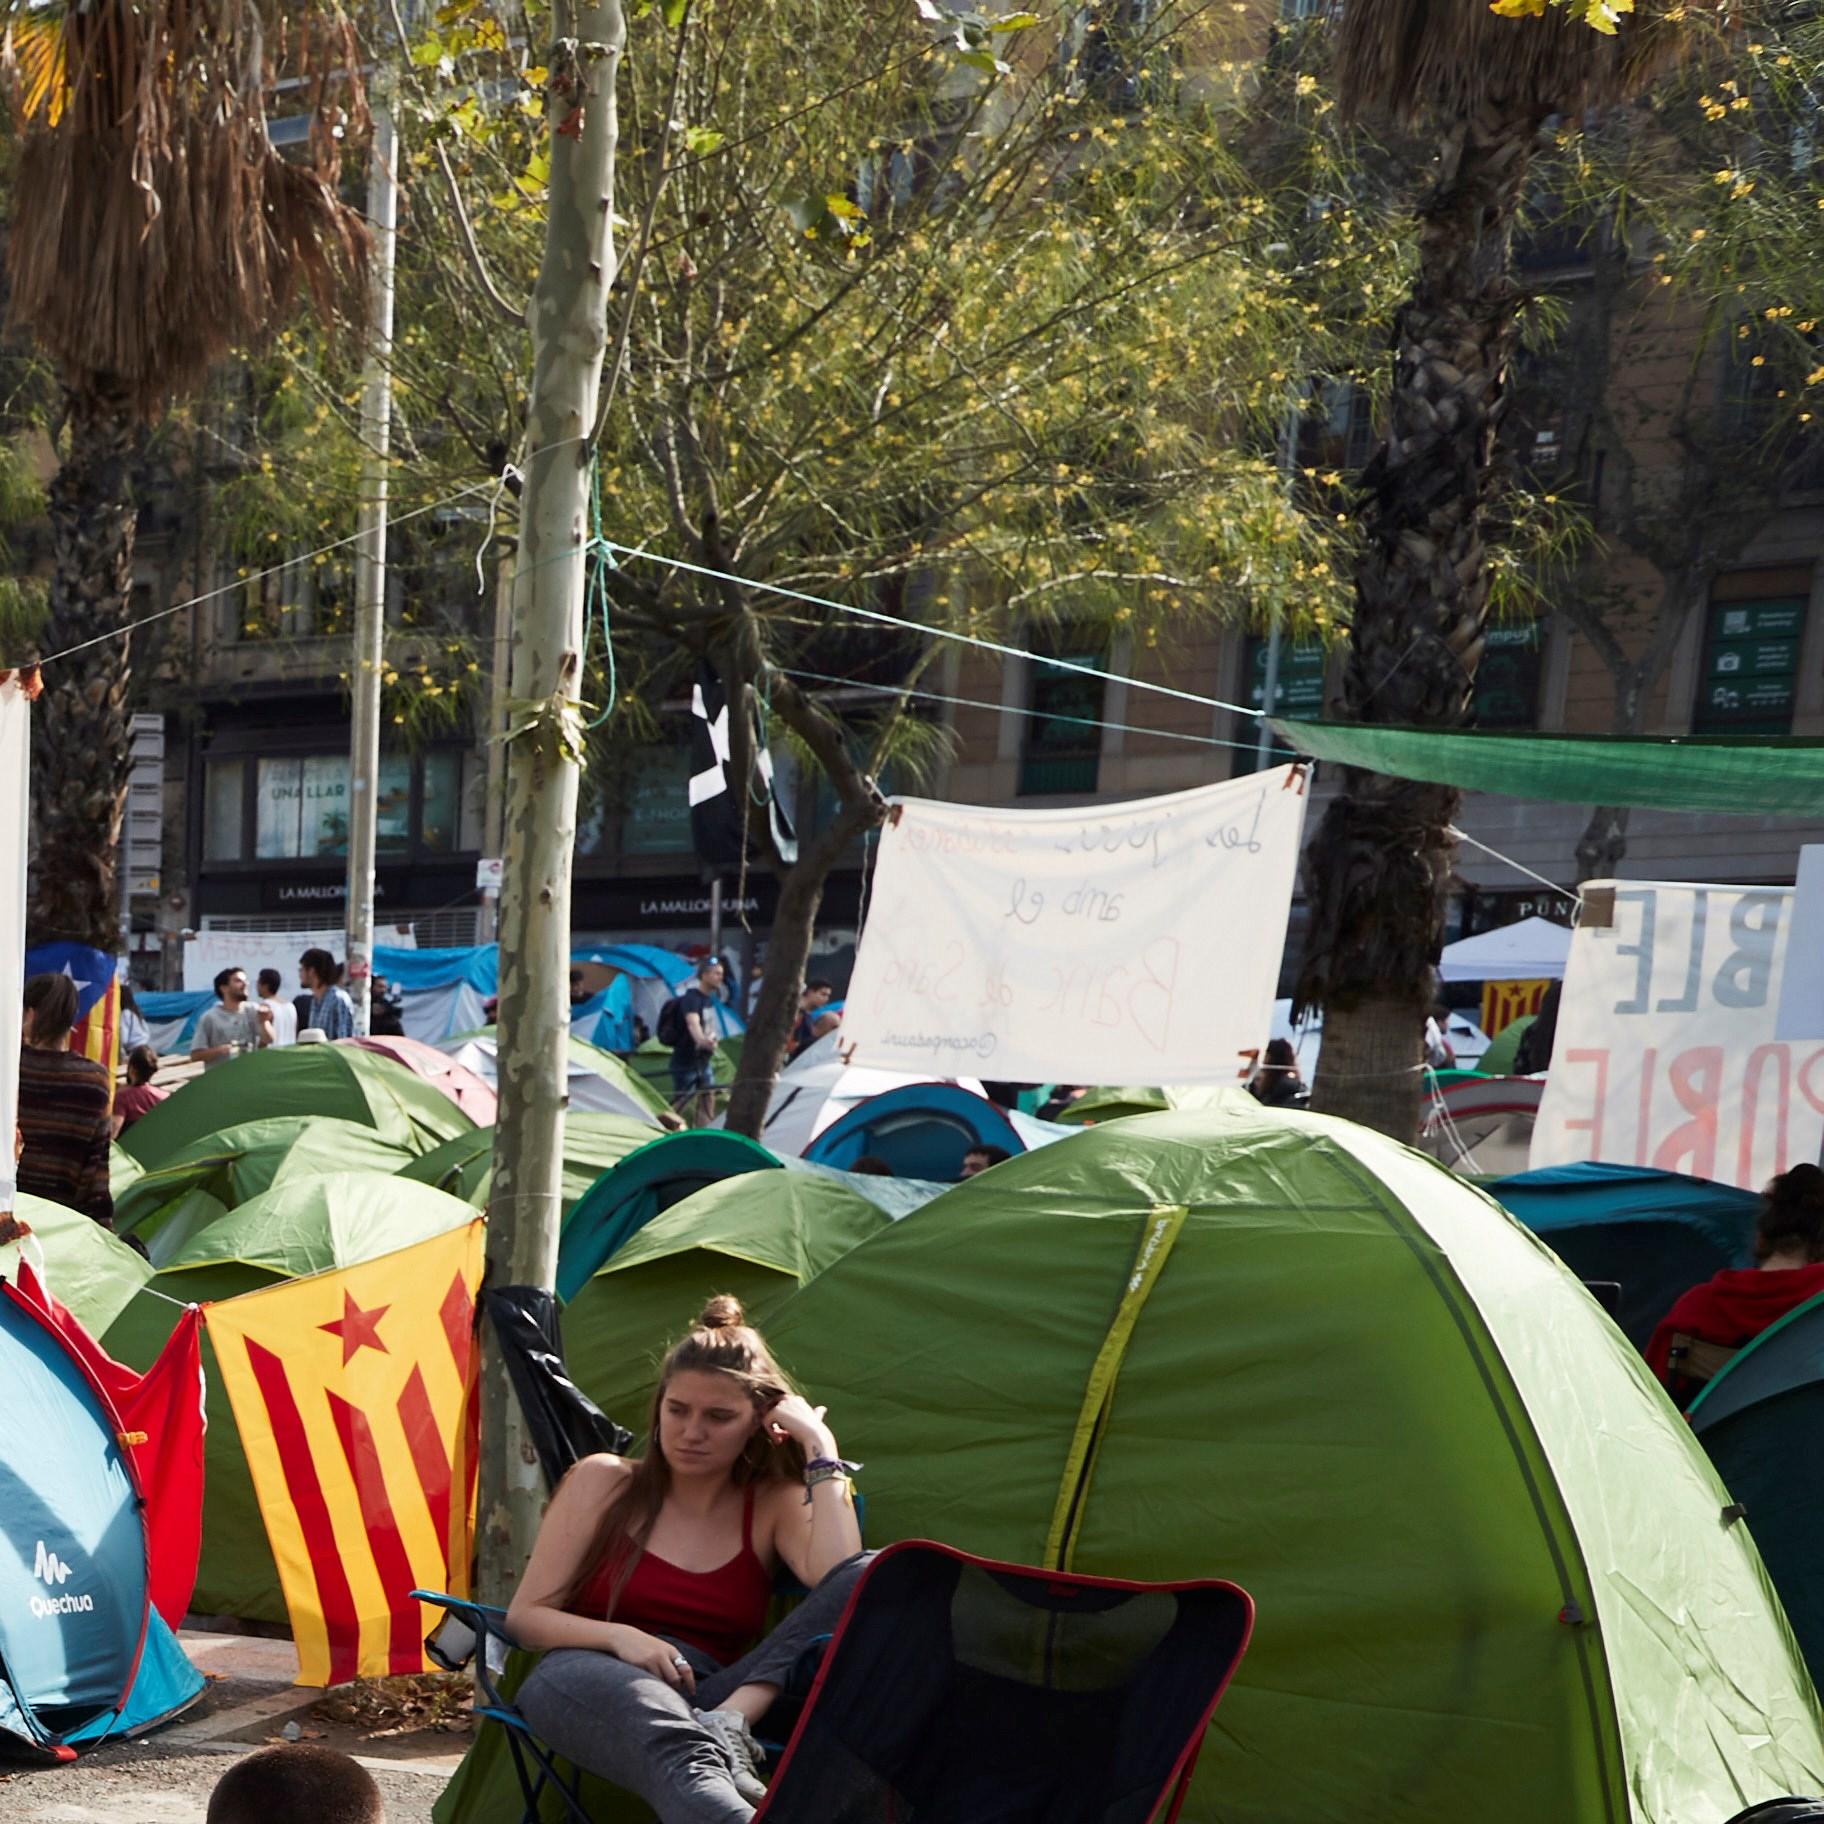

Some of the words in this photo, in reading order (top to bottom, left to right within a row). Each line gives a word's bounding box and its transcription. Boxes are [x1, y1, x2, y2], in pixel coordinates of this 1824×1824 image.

[307, 784, 345, 799] LLAR
[279, 886, 296, 900] LA
[640, 902, 658, 914] LA
[30, 1592, 93, 1620] Quechua
